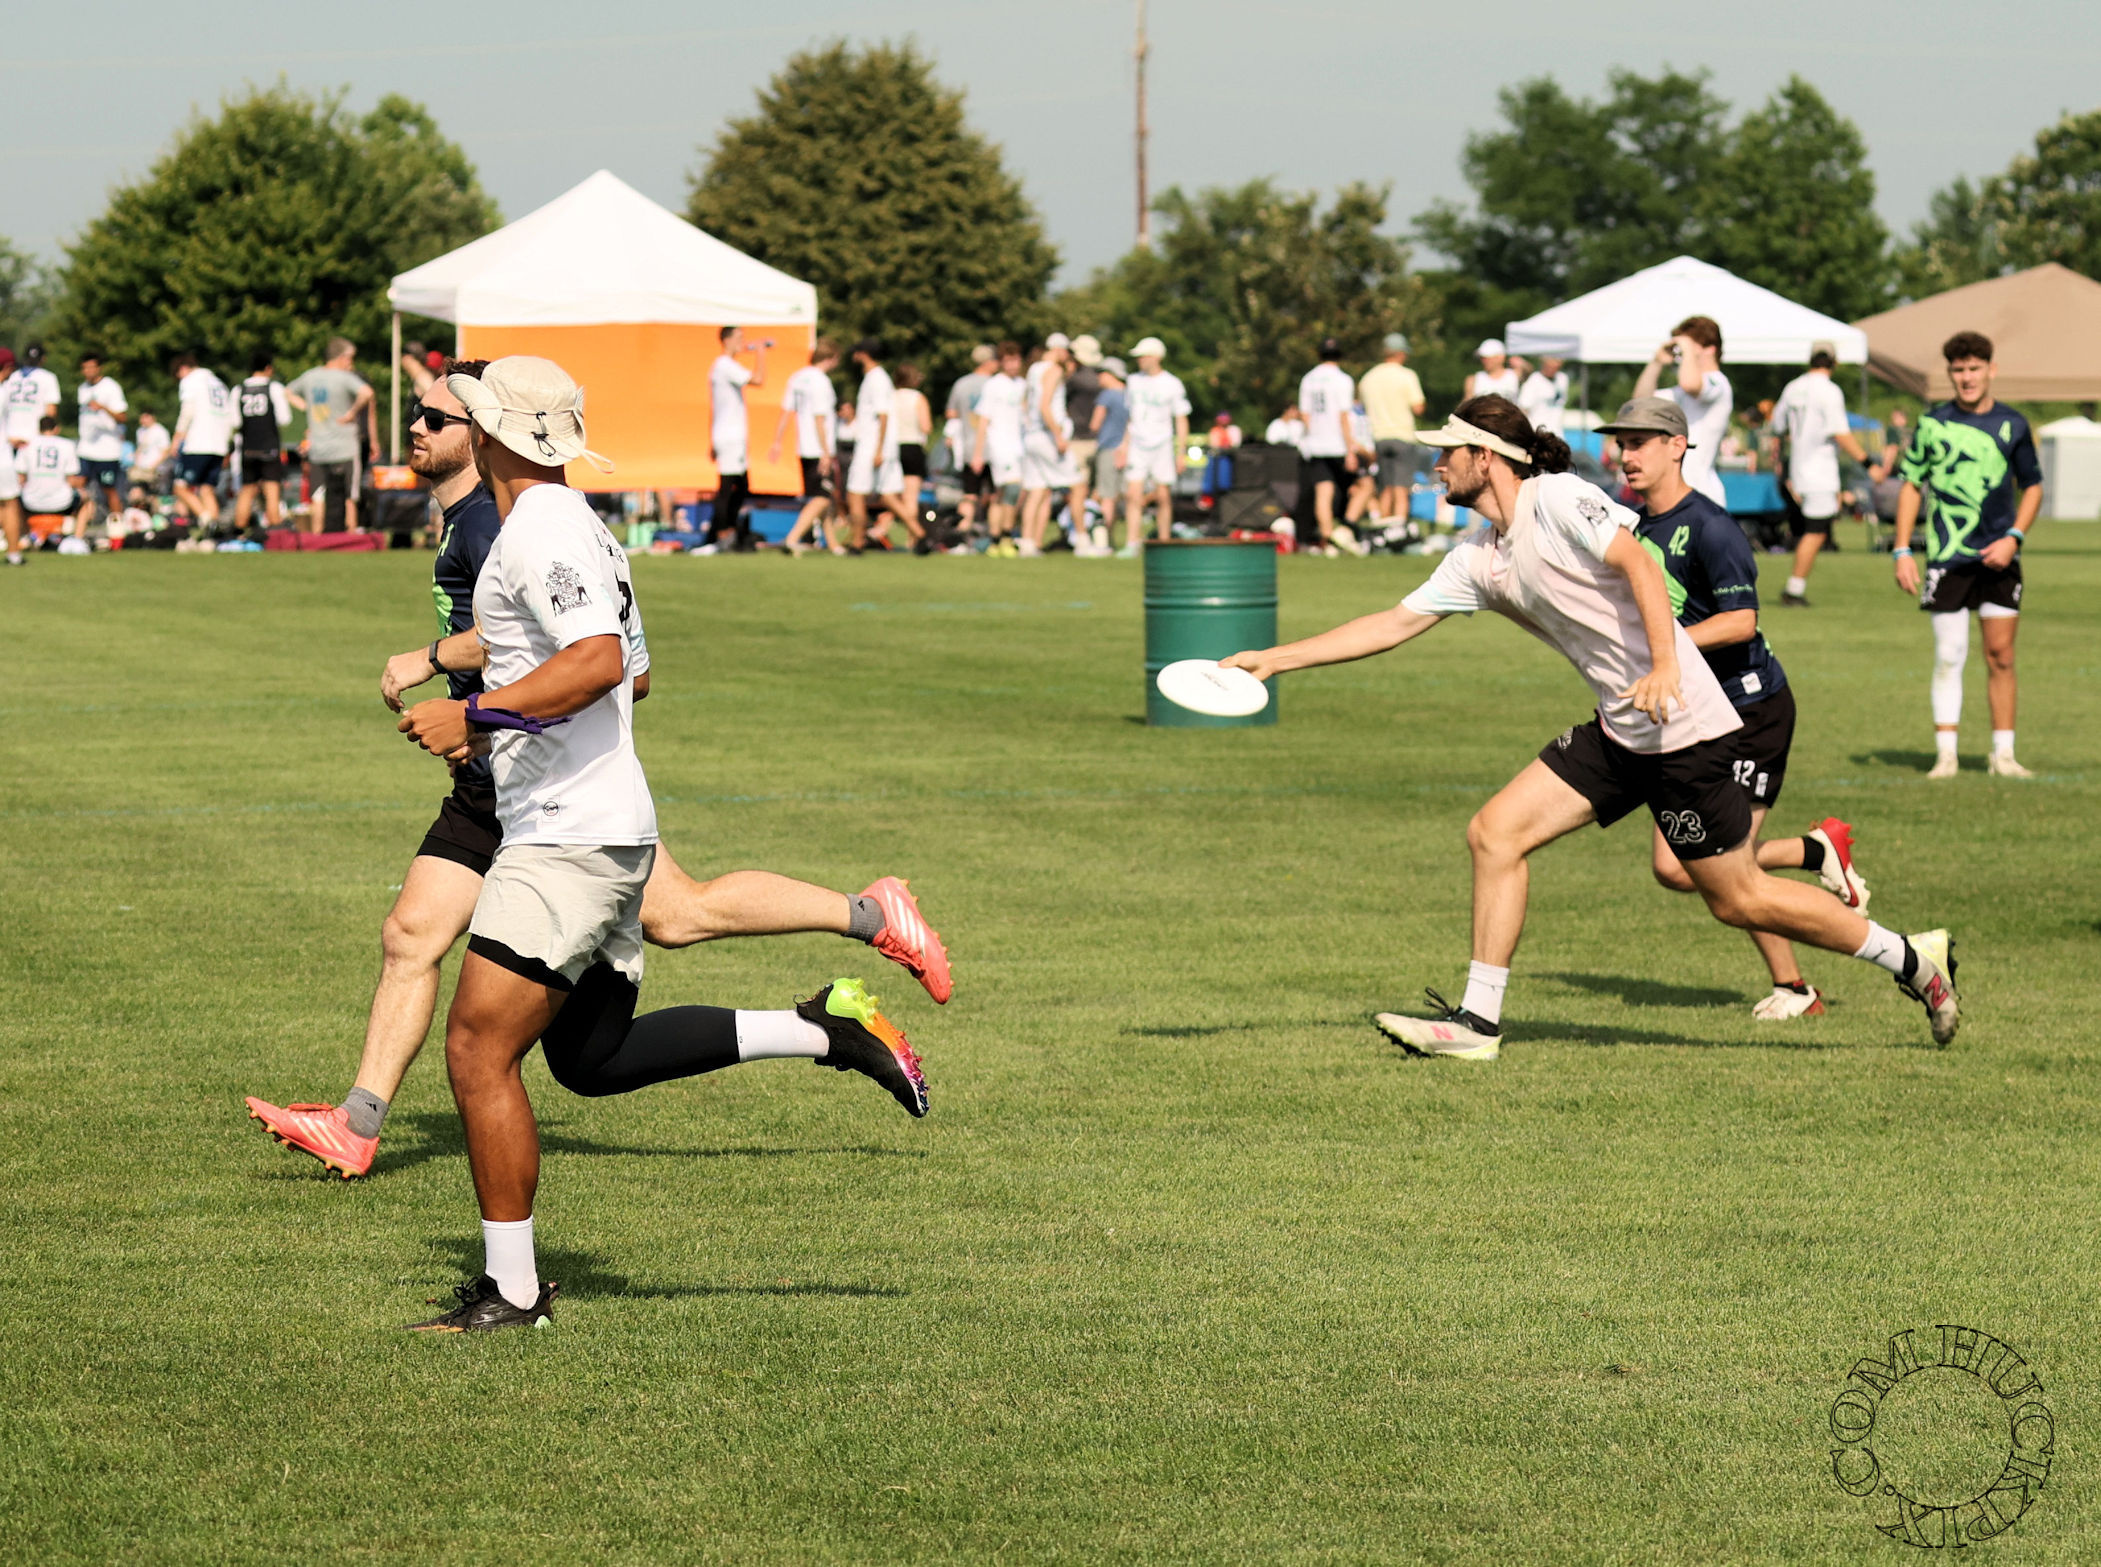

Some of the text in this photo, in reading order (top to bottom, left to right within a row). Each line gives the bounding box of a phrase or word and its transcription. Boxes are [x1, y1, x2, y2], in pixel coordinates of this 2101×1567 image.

[9, 381, 39, 404] 22
[1999, 420, 2012, 444] 4
[36, 444, 59, 469] 19
[1668, 525, 1690, 556] 42
[1661, 810, 1706, 845] 23
